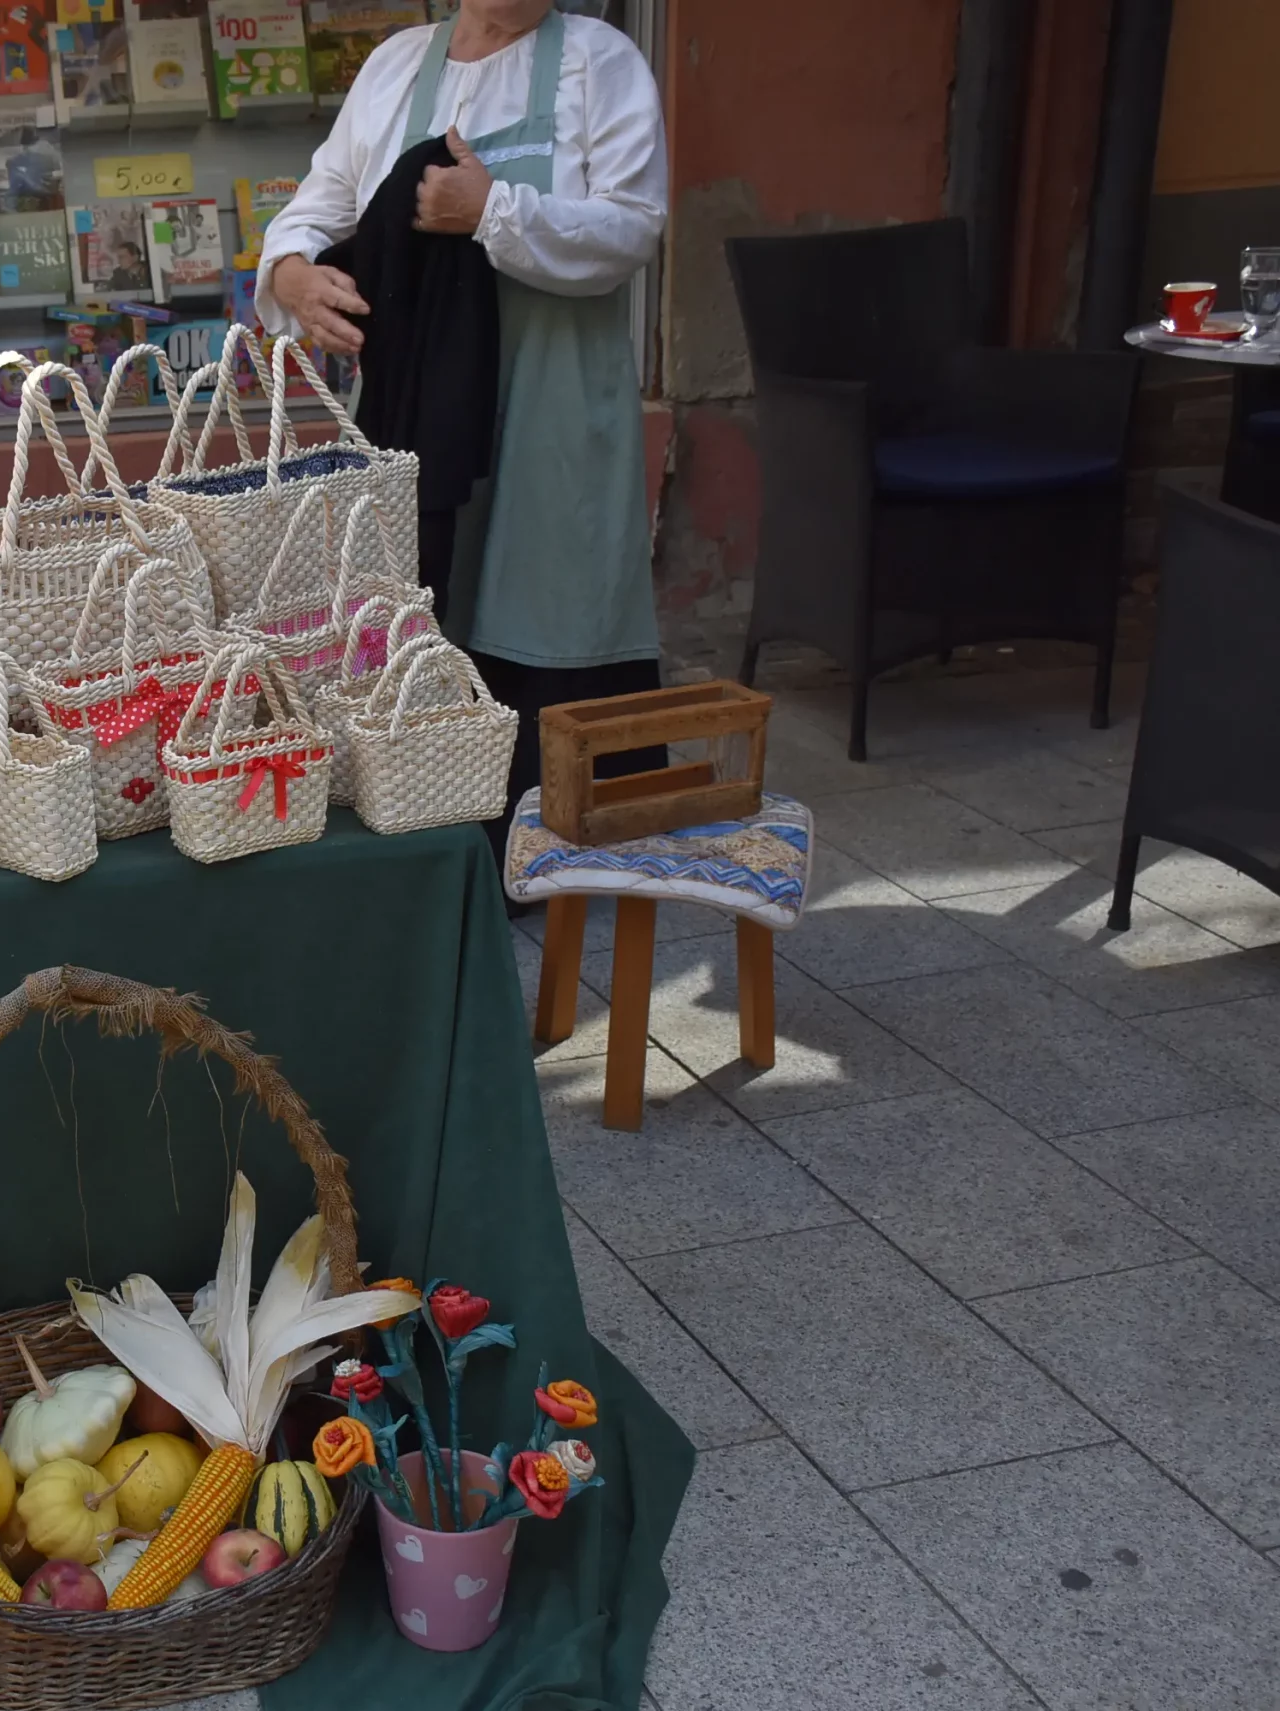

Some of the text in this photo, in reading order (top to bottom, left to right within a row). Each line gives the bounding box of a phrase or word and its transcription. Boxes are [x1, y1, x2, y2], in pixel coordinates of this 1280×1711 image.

[215, 17, 257, 41] 100
[116, 167, 167, 191] 5,00
[0, 238, 65, 256] TERAN
[34, 251, 66, 268] SKI
[169, 328, 210, 370] OK
